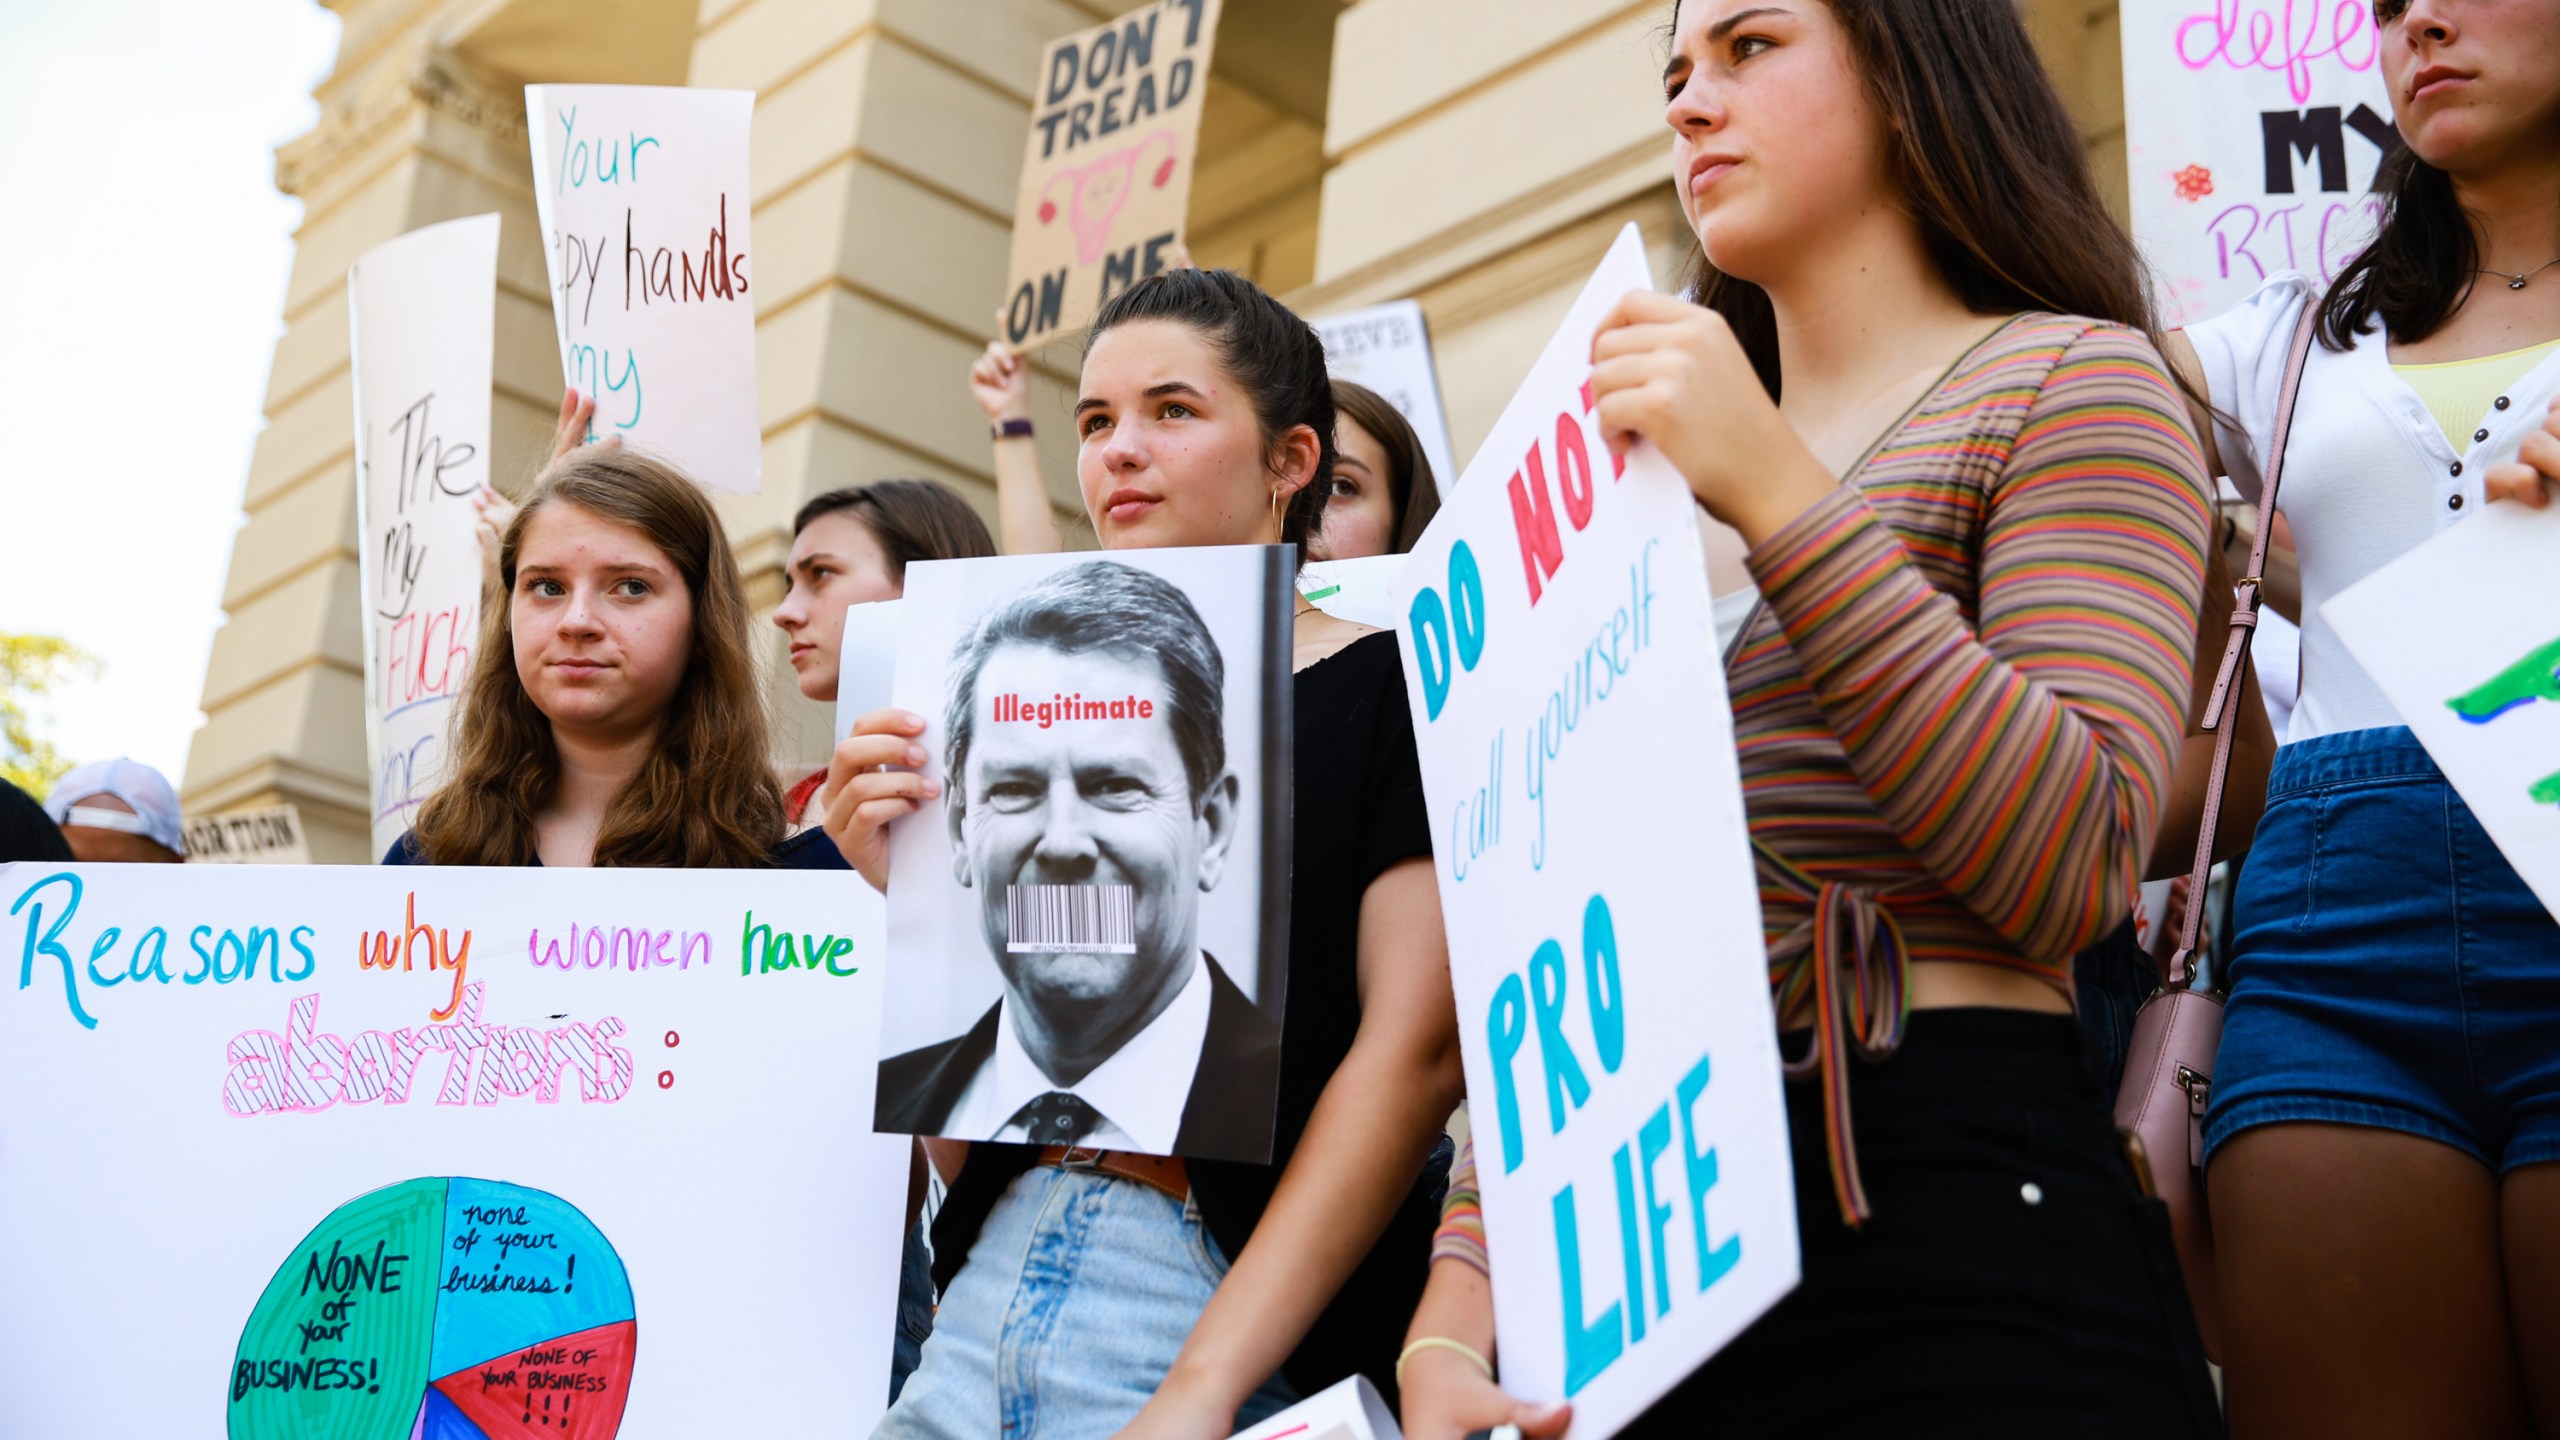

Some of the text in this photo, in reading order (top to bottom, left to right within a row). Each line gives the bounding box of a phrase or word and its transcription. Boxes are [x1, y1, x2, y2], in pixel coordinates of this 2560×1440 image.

[2175, 0, 2382, 104] defe
[558, 103, 660, 196] Your
[1037, 57, 1194, 158] TREAD
[2260, 102, 2402, 194] MY
[626, 192, 748, 311] hands
[1009, 231, 1175, 344] ON ME
[389, 393, 482, 514] The
[1408, 539, 1486, 723] DO
[993, 692, 1153, 729] Illegitimate
[1452, 537, 1659, 882] call yourself
[10, 872, 859, 1030] Reasons why women have
[222, 979, 634, 1118] abortions
[1487, 893, 1625, 1176] PRO
[453, 1228, 558, 1259] of your
[463, 1205, 531, 1226] none
[1552, 1050, 1742, 1399] LIFE
[301, 1240, 409, 1296] NONE
[322, 1291, 357, 1322] of
[234, 1356, 379, 1402] BUSINESS!
[519, 1347, 599, 1369] NONE OF
[527, 1369, 608, 1392] BUSINESS
